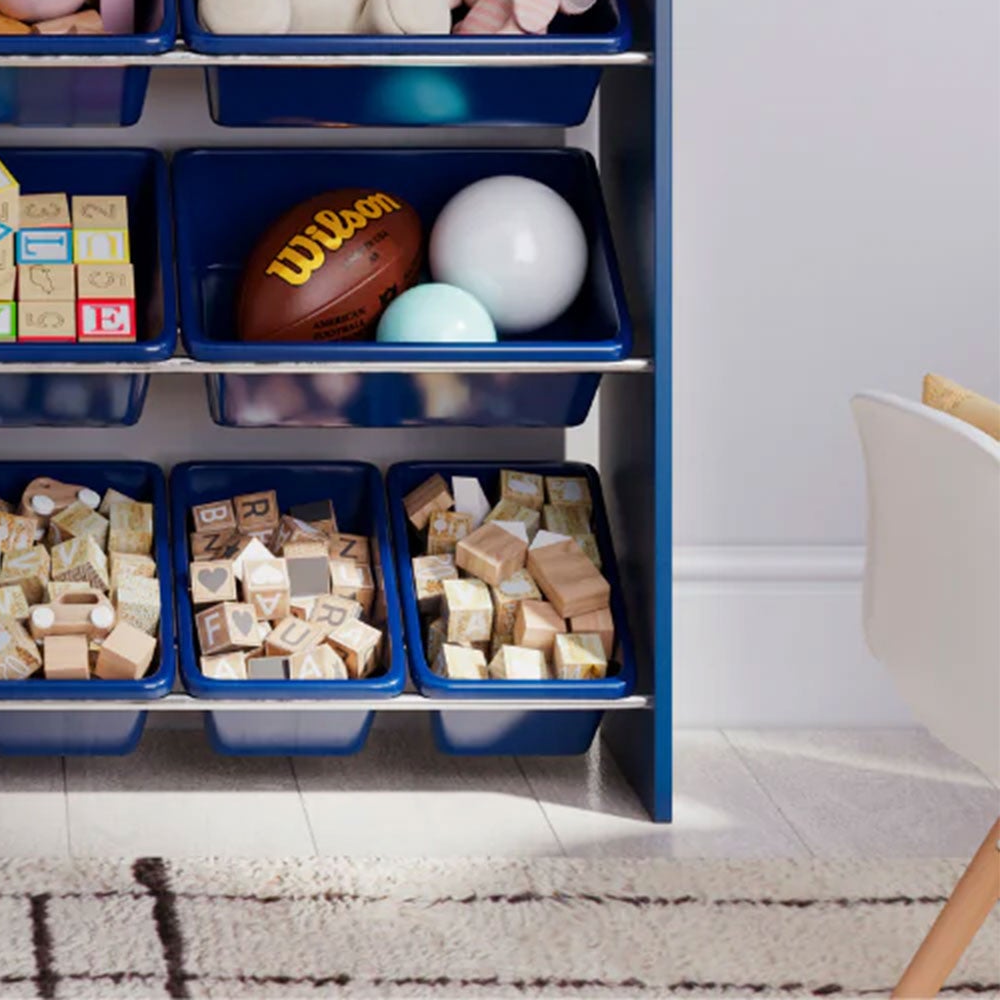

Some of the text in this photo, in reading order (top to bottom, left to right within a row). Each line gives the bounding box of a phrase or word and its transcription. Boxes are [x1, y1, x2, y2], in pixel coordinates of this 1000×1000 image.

[264, 192, 401, 286] Wilson
[88, 304, 126, 332] E
[242, 499, 270, 517] R
[203, 612, 220, 646] F
